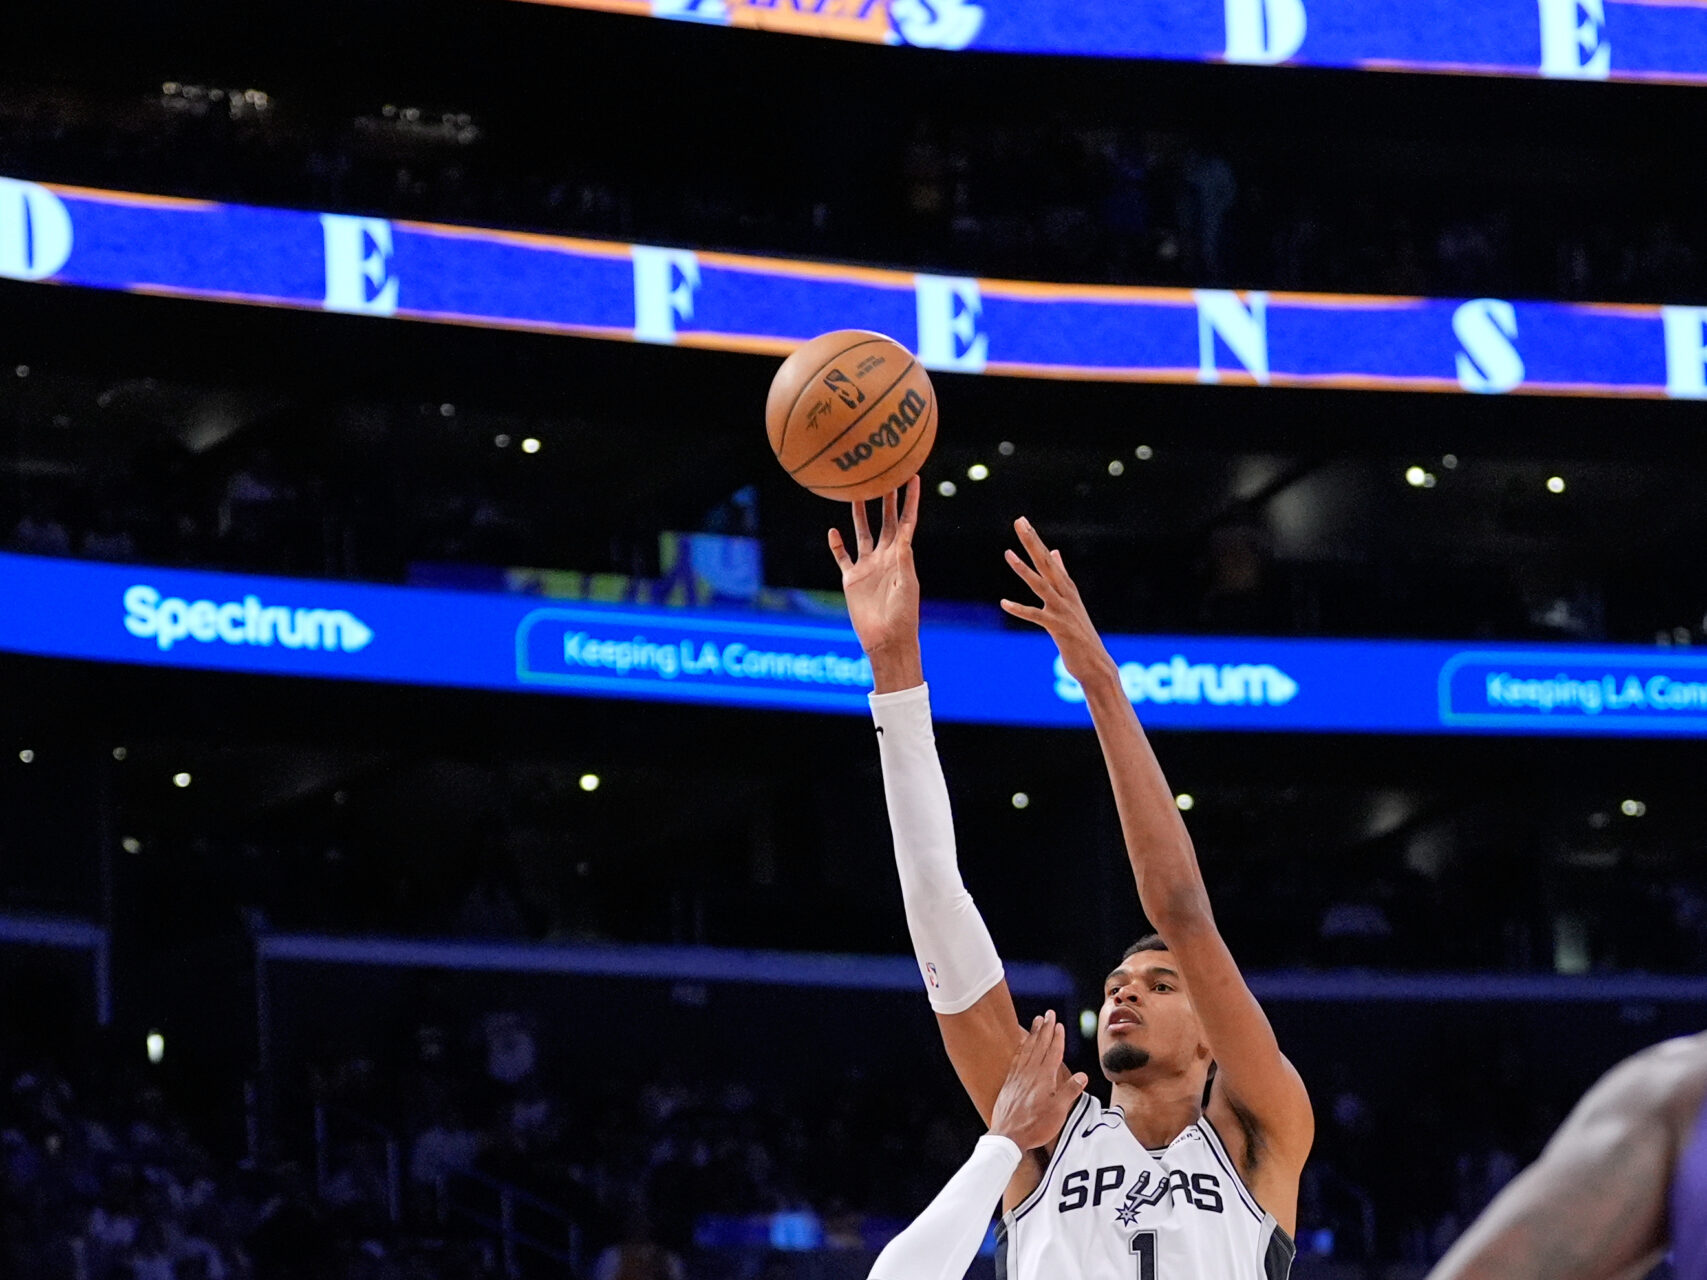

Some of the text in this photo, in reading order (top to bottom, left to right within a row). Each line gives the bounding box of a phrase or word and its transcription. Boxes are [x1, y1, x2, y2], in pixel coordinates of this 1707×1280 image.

[122, 584, 375, 653] Spectrum
[563, 630, 680, 679] Keeping
[679, 638, 724, 676] LA
[1053, 654, 1299, 706] Sectrum
[1485, 671, 1602, 716] Keeping
[1602, 674, 1646, 710] LA
[1058, 1164, 1224, 1228] SPURS
